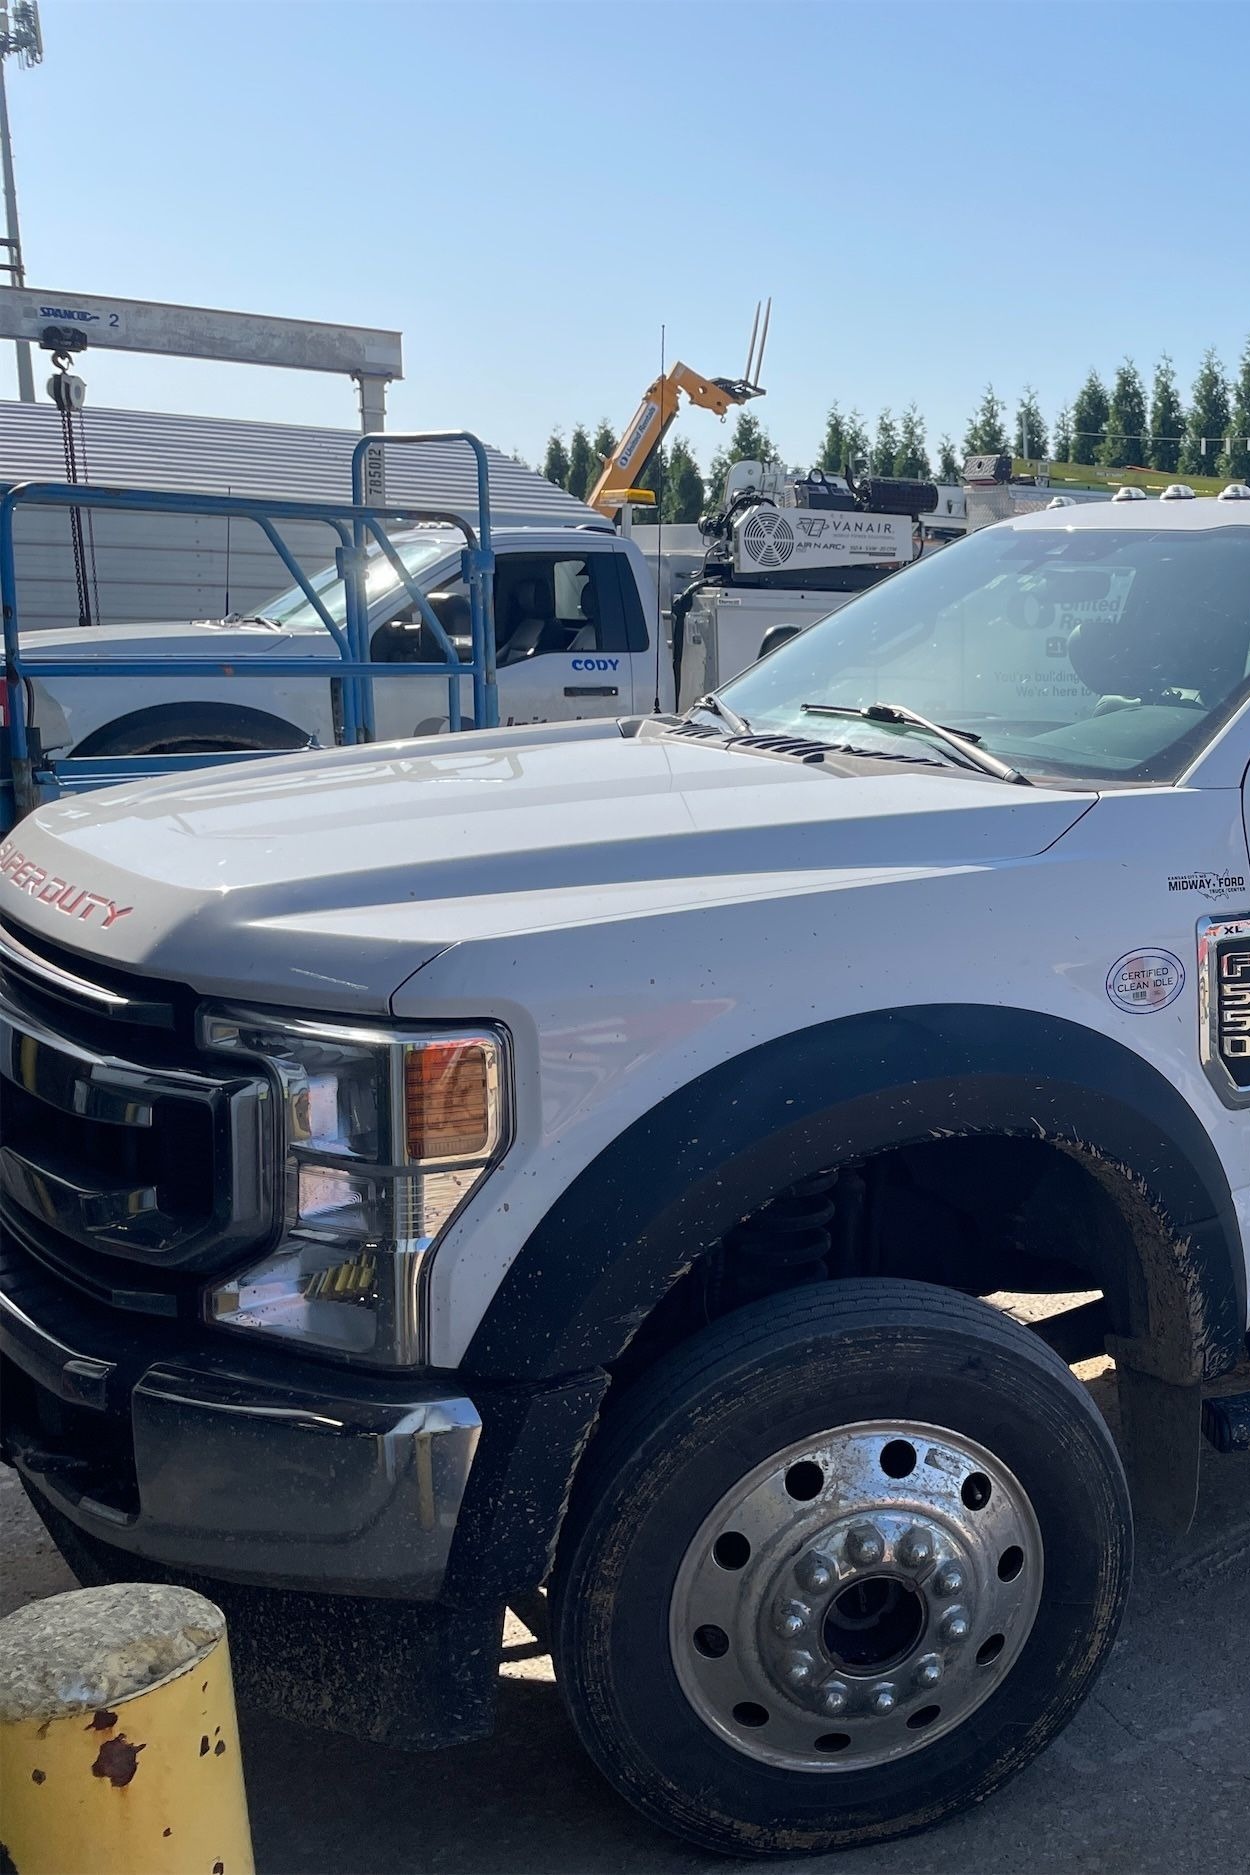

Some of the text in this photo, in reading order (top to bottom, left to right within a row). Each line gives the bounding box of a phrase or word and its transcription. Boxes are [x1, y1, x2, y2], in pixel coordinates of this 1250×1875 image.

[109, 313, 119, 327] 2
[626, 406, 656, 456] United Rentals
[368, 449, 382, 495] 785012
[832, 520, 893, 534] VANAIR
[571, 658, 620, 671] CODY
[1034, 672, 1080, 685] building
[1052, 686, 1079, 697] here
[1168, 876, 1244, 891] MIDWAY FORD
[37, 877, 134, 930] DUTY
[1224, 926, 1243, 935] XL
[1121, 967, 1169, 981] CERTIFIED
[1117, 981, 1149, 993] CLEAN
[1153, 977, 1174, 987] IDLE
